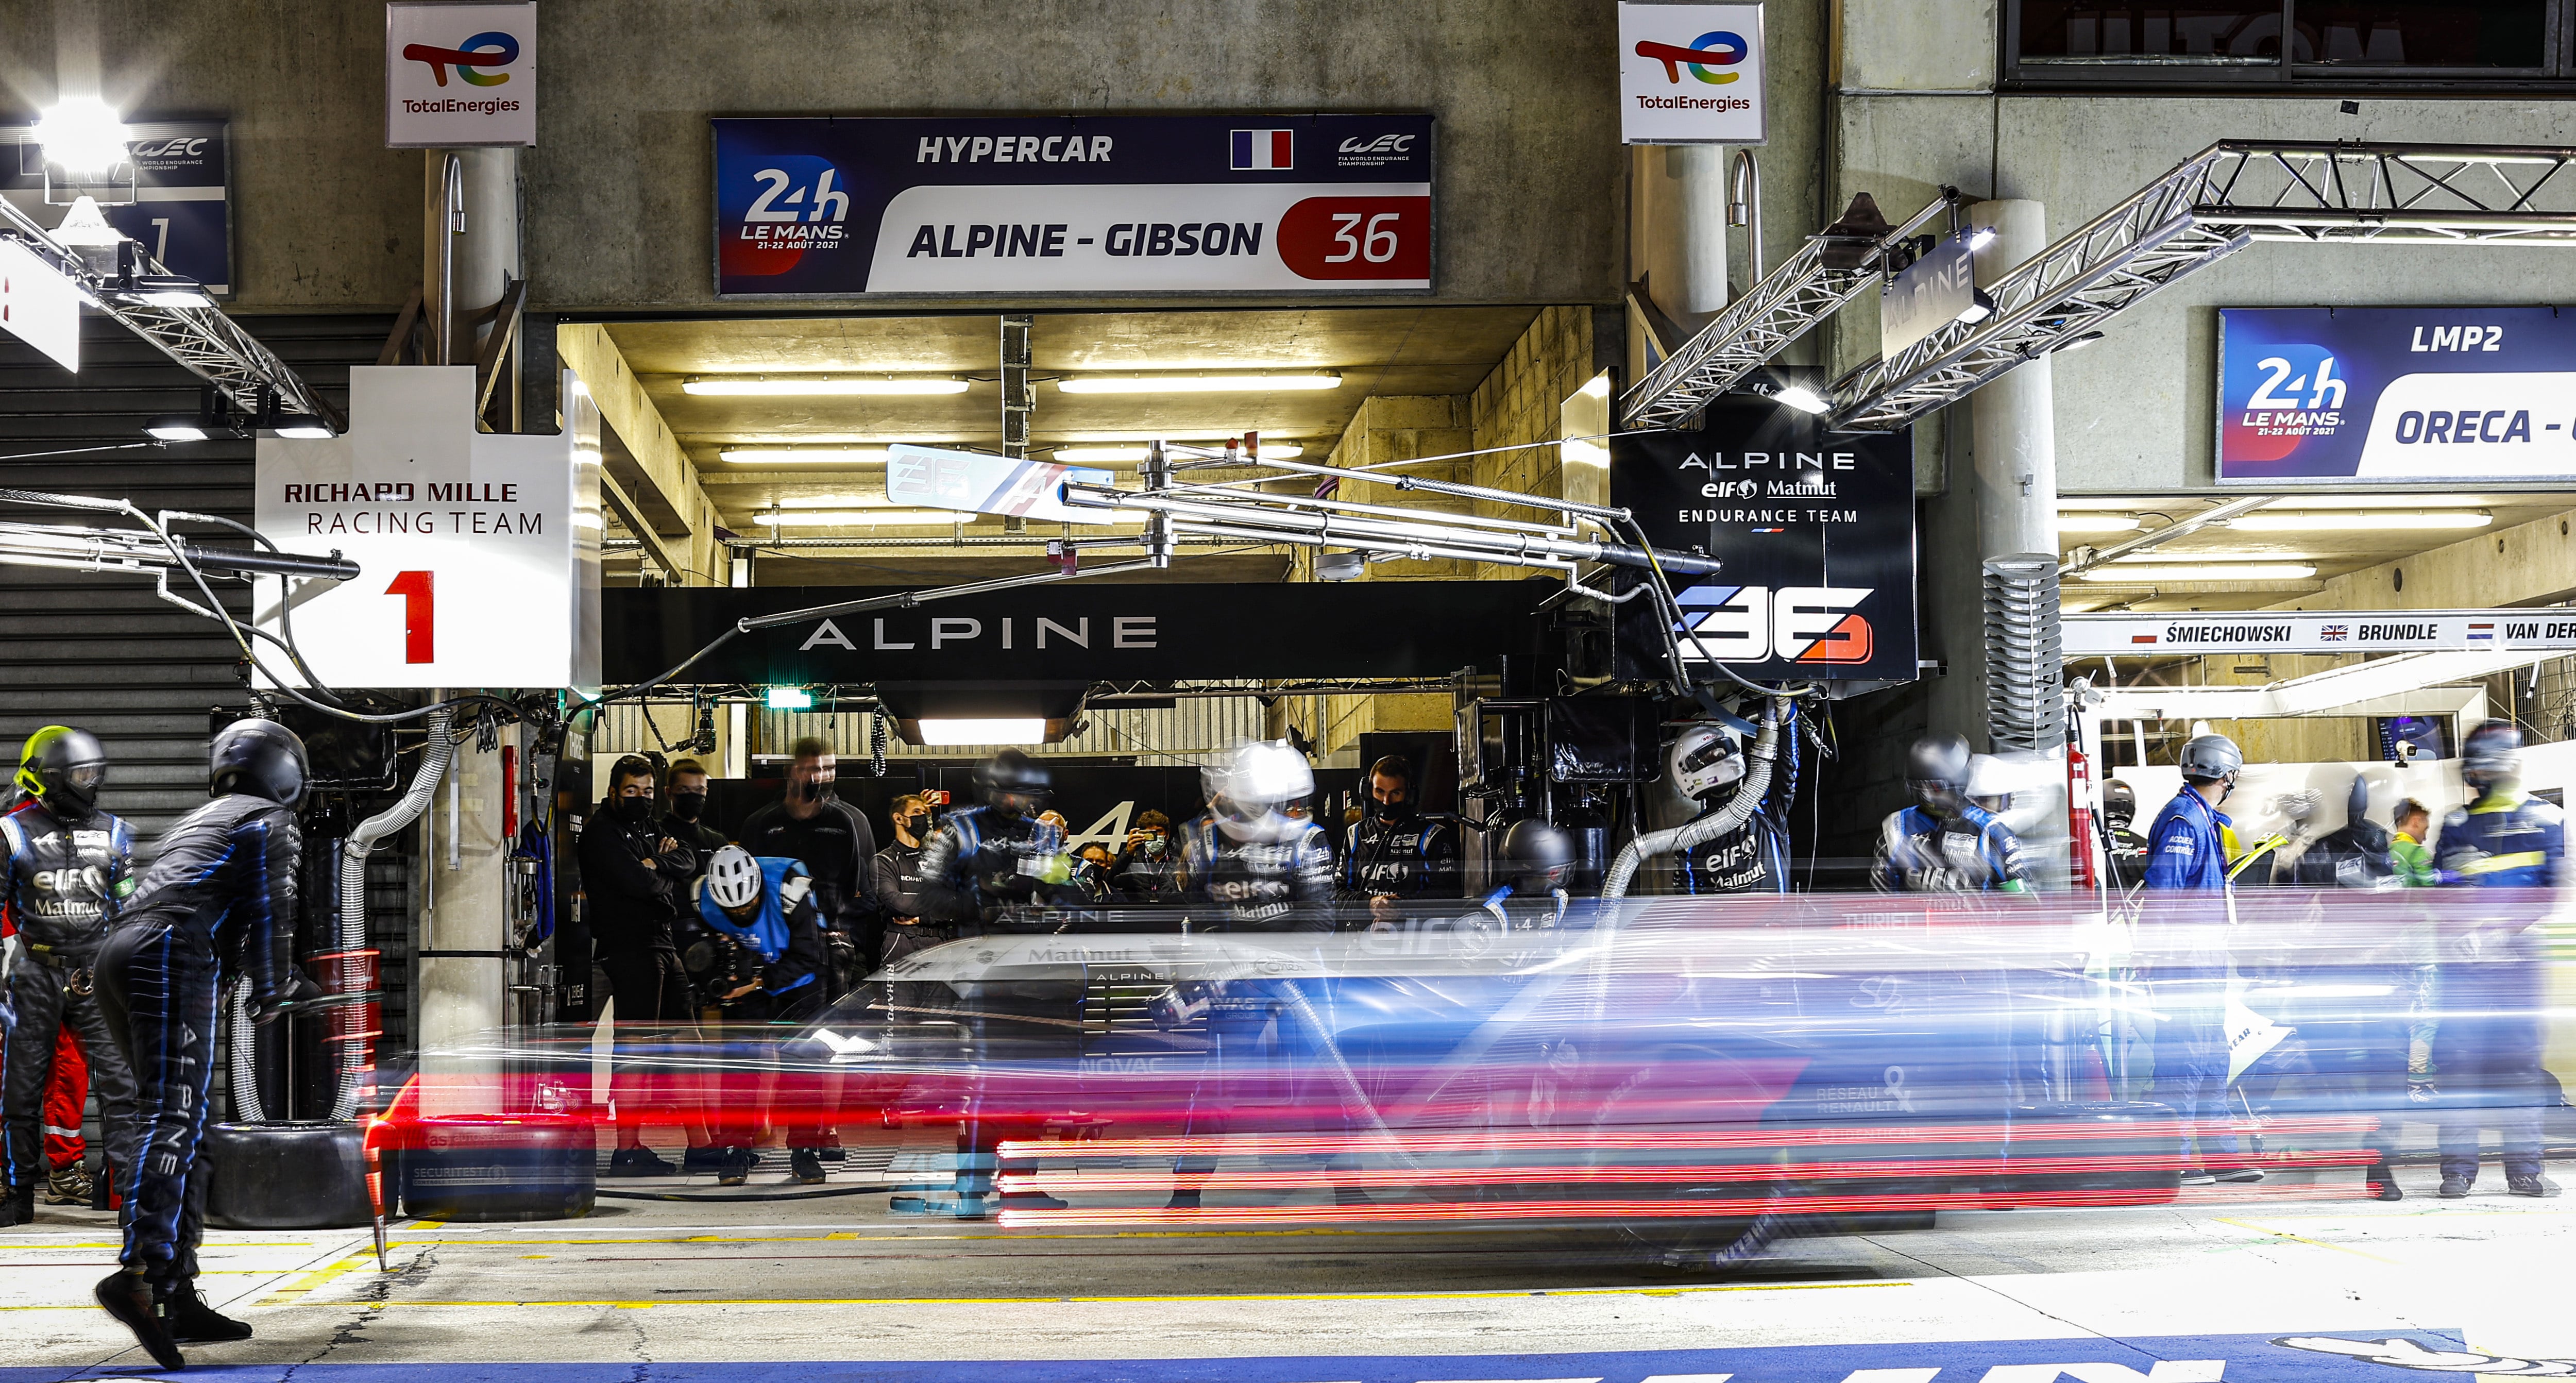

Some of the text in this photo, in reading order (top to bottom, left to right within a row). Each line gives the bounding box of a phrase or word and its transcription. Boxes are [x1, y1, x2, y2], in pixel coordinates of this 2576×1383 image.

[402, 97, 520, 115] TotalEnergies
[1636, 95, 1750, 113] TotalEnergies
[131, 138, 208, 157] WEC
[918, 136, 1113, 163] HYPERCAR
[1338, 134, 1416, 153] WEC
[744, 168, 850, 222] 24h
[151, 218, 169, 265] 1
[741, 226, 770, 240] LE
[908, 224, 1068, 258] ALPINE
[1105, 222, 1262, 257] GIBSON
[1325, 213, 1400, 263] 36
[786, 240, 814, 249] AOÛT
[1886, 252, 1969, 334] ALPINE
[2411, 326, 2503, 352] LMP2
[2246, 357, 2347, 410] 24h
[2242, 412, 2272, 426] LE
[2396, 410, 2531, 444] ORECA
[2285, 426, 2311, 435] AOÛT
[1678, 452, 1855, 469] ALPINE
[285, 482, 517, 503] RICHARD MILLE
[1702, 480, 1837, 497] elf Matmut
[308, 512, 543, 535] RACING TEAM
[1679, 510, 1858, 522] ENDURANCE TEAM
[384, 570, 434, 664] 1
[1662, 586, 1874, 664] 36
[799, 617, 1157, 650] ALPINE
[2166, 622, 2291, 644] ŚMIECHOWSKI
[2358, 623, 2437, 642] BRUNDLE
[2505, 623, 2539, 639] VAN
[2169, 835, 2194, 846] ACCUEIL
[1706, 844, 1741, 872] elf
[2165, 845, 2195, 856] CONTRÔLE
[994, 910, 1124, 923] ALPINE
[1360, 917, 1446, 955] elf
[1028, 948, 1133, 963] Matmut
[1096, 973, 1164, 981] ALPINE
[159, 1021, 198, 1175] ALPINE
[1817, 1101, 1893, 1114] RENAULT
[414, 1167, 485, 1178] SECURITEST
[1716, 1186, 1782, 1266] MCHELIN
